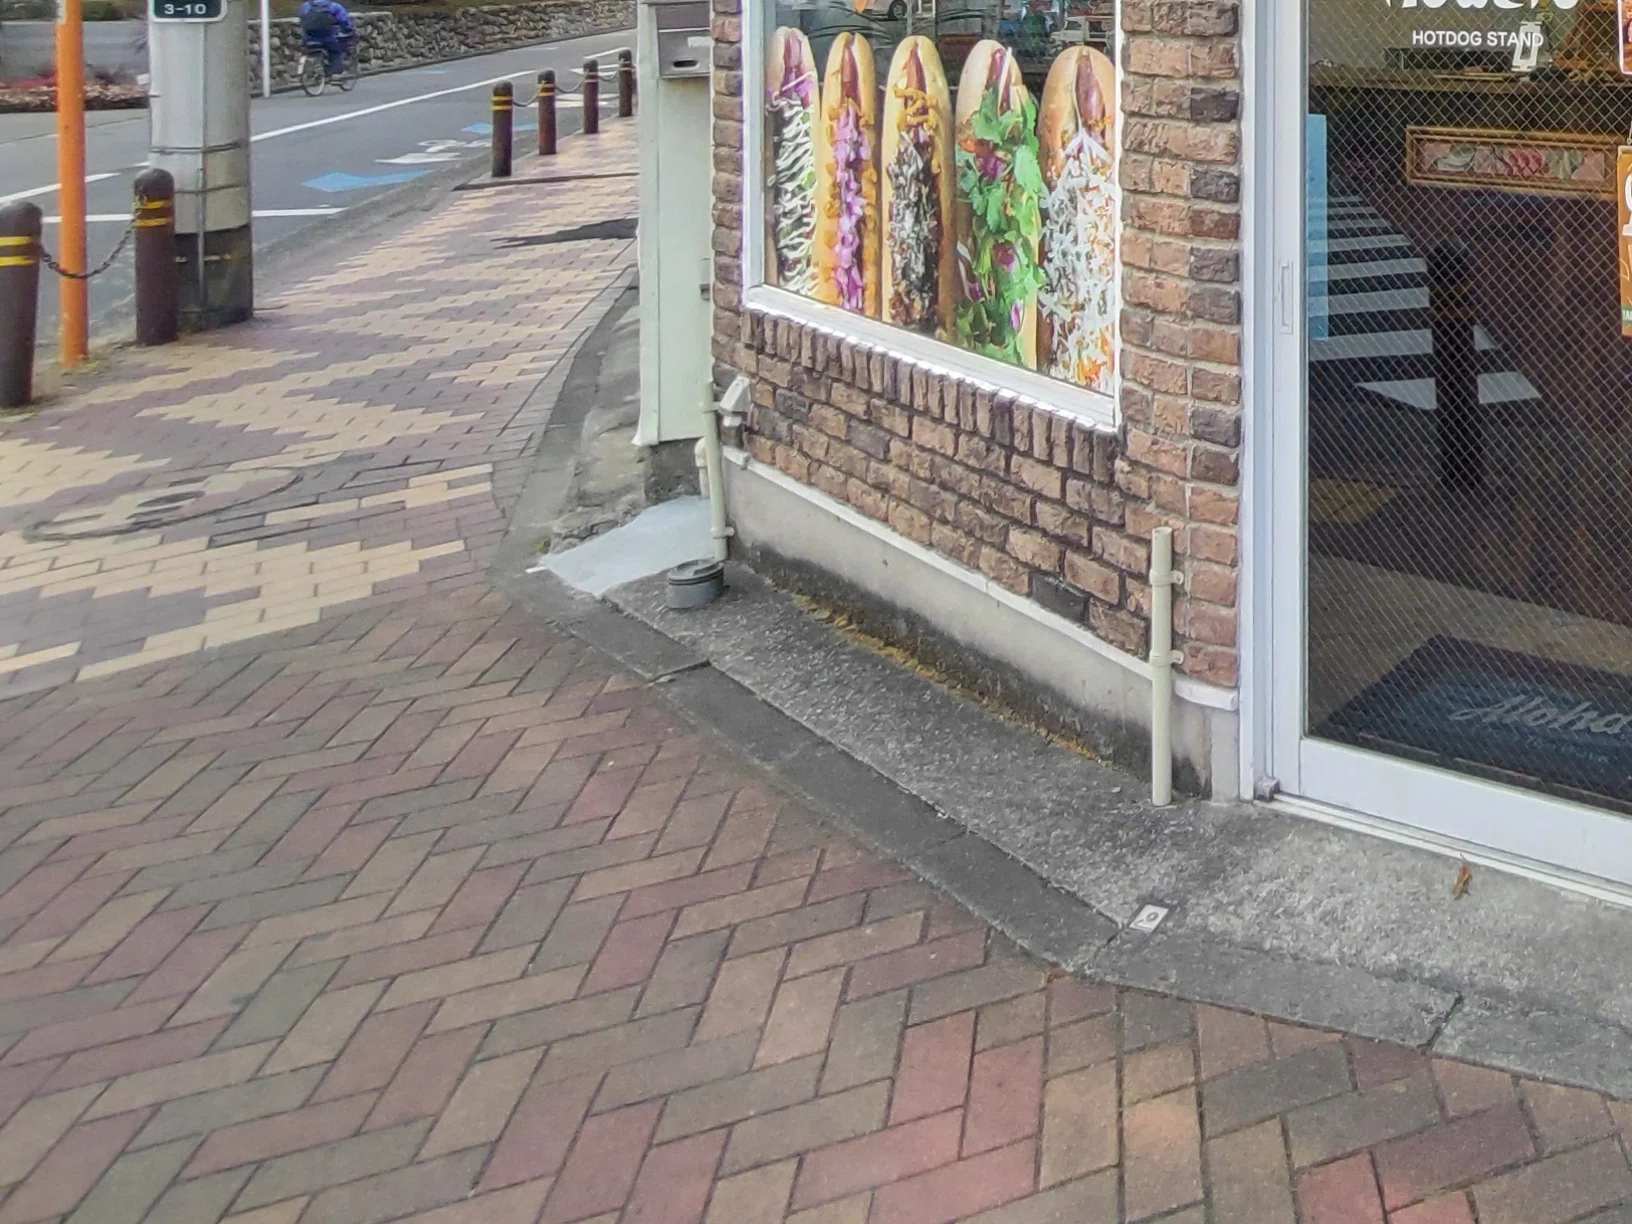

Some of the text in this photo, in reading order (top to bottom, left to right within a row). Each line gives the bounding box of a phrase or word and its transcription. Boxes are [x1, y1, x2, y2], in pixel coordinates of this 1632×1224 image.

[164, 3, 207, 16] 3-10
[1412, 30, 1545, 48] HOTDOG STAND
